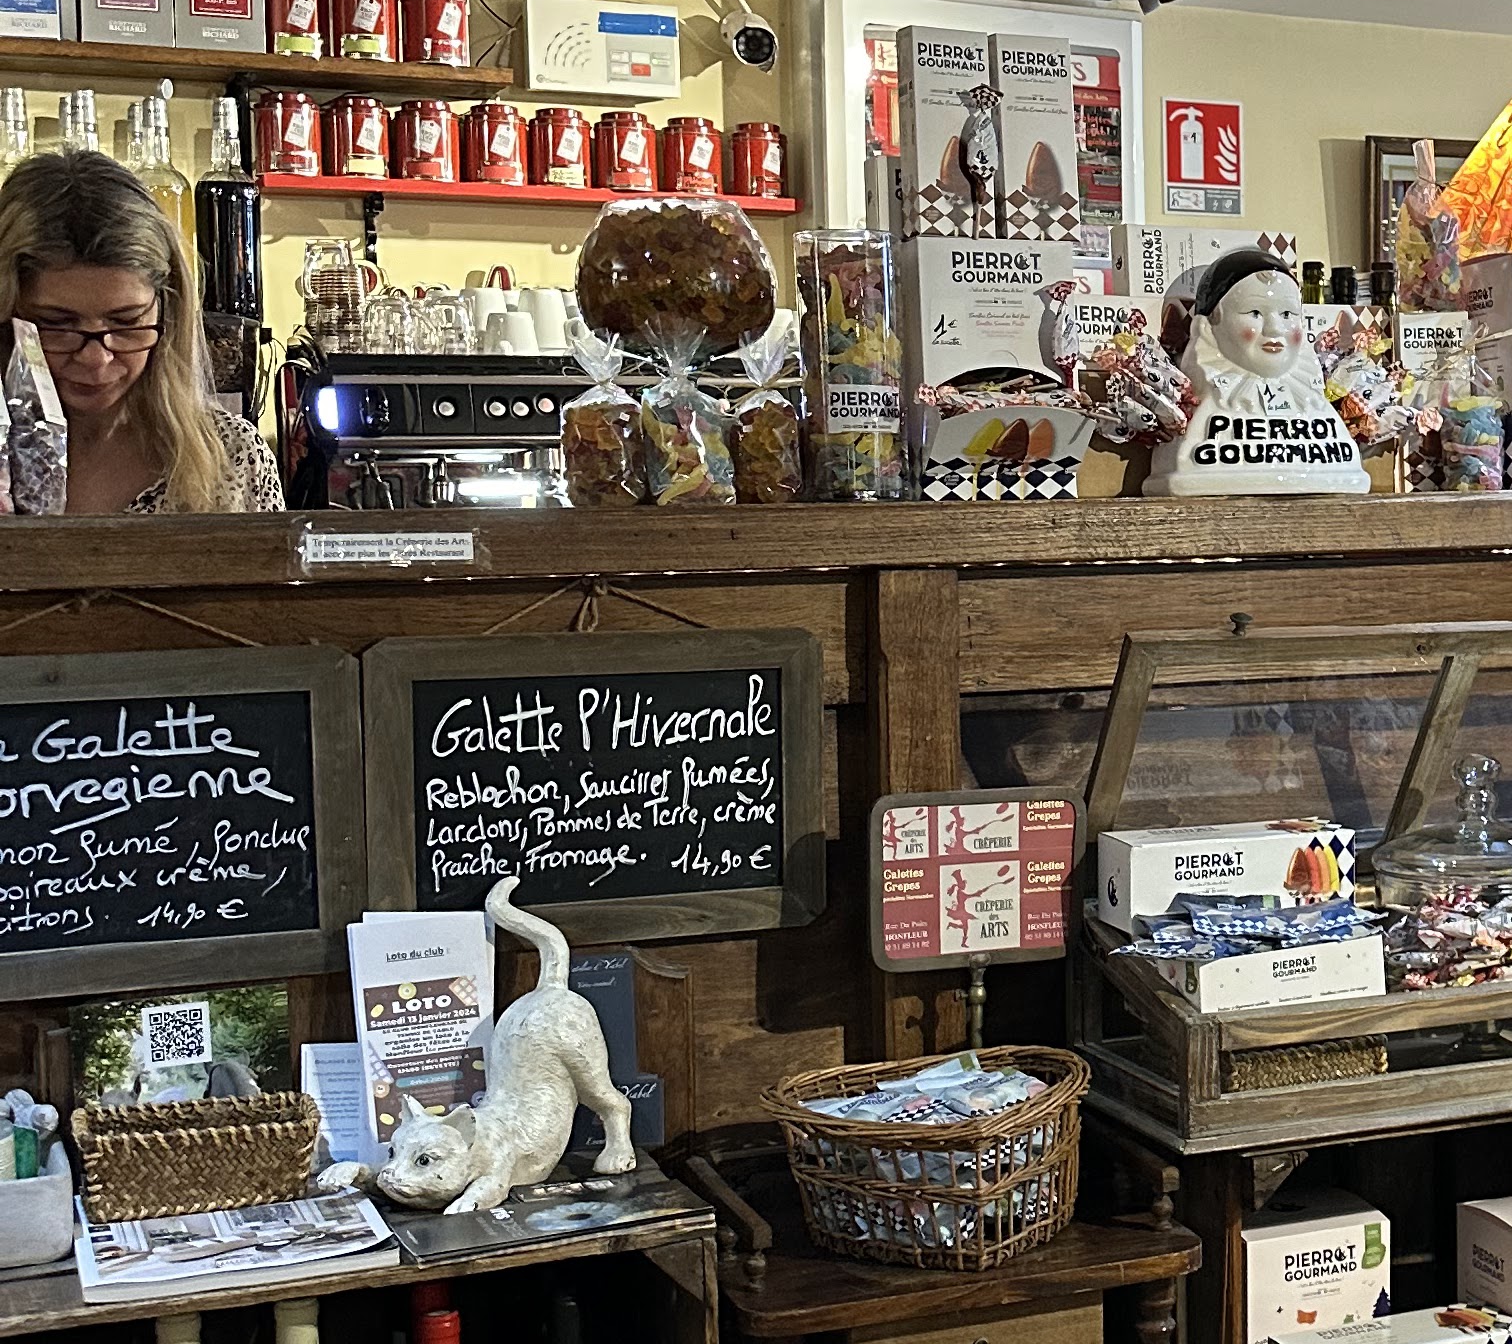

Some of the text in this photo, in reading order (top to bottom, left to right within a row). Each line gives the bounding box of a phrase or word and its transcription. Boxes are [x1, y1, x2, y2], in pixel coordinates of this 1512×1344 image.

[917, 42, 984, 61] PIERROT
[1001, 50, 1066, 67] PIERROT
[917, 57, 986, 72] GOURMAND
[1002, 64, 1068, 78] GOURMAND
[951, 251, 1042, 271] PIERROT
[1142, 229, 1156, 294] PIERROT
[1153, 229, 1164, 295] GOURMAND
[951, 270, 1044, 285] GOURMAND
[1074, 305, 1130, 324] IERRO
[1074, 322, 1135, 337] OURMAN
[1403, 327, 1464, 341] PIERROT
[1403, 340, 1464, 350] GOURMAND
[829, 392, 900, 407] PIERROT
[829, 406, 901, 419] GOURMAND
[1206, 415, 1338, 440] PIERROT
[1194, 441, 1353, 465] GOURMAND
[385, 537, 393, 546] la
[434, 538, 449, 546] des
[431, 673, 777, 758] Galette l'Hivernale
[31, 701, 260, 763] Galette
[426, 765, 571, 814] Reblochon,
[0, 765, 295, 834] orvegienne
[1026, 801, 1065, 809] Galettes
[529, 806, 611, 837] Pommes
[617, 804, 643, 830] de
[643, 798, 708, 838] Terre,
[713, 790, 776, 824] crème
[904, 843, 924, 854] ARTS
[973, 836, 1012, 850] CRÊPERIE
[0, 841, 70, 864] mon
[1174, 851, 1244, 870] PIERROT
[524, 841, 647, 887] Fromage.
[671, 843, 742, 878] 14,90
[748, 844, 772, 871] €
[1026, 861, 1065, 872] Galettes
[883, 868, 925, 880] Galettes
[1174, 866, 1245, 881] GOURMAND
[137, 901, 206, 929] 14,90
[216, 898, 249, 921] €
[974, 899, 1014, 913] CRÊPERIE
[988, 912, 1000, 922] des
[885, 931, 929, 942] HONFLEUR
[980, 921, 1009, 939] ARTS
[386, 946, 444, 962] Loto du club
[1272, 955, 1317, 971] PIERROT
[1272, 966, 1318, 979] GOURMAND
[391, 994, 452, 1014] LOTO
[370, 1016, 406, 1029] Samedi
[418, 1010, 452, 1024] janvier
[453, 1008, 477, 1017] 2024
[1284, 1244, 1356, 1271] PIERROT
[1284, 1261, 1357, 1282] GOURMAND
